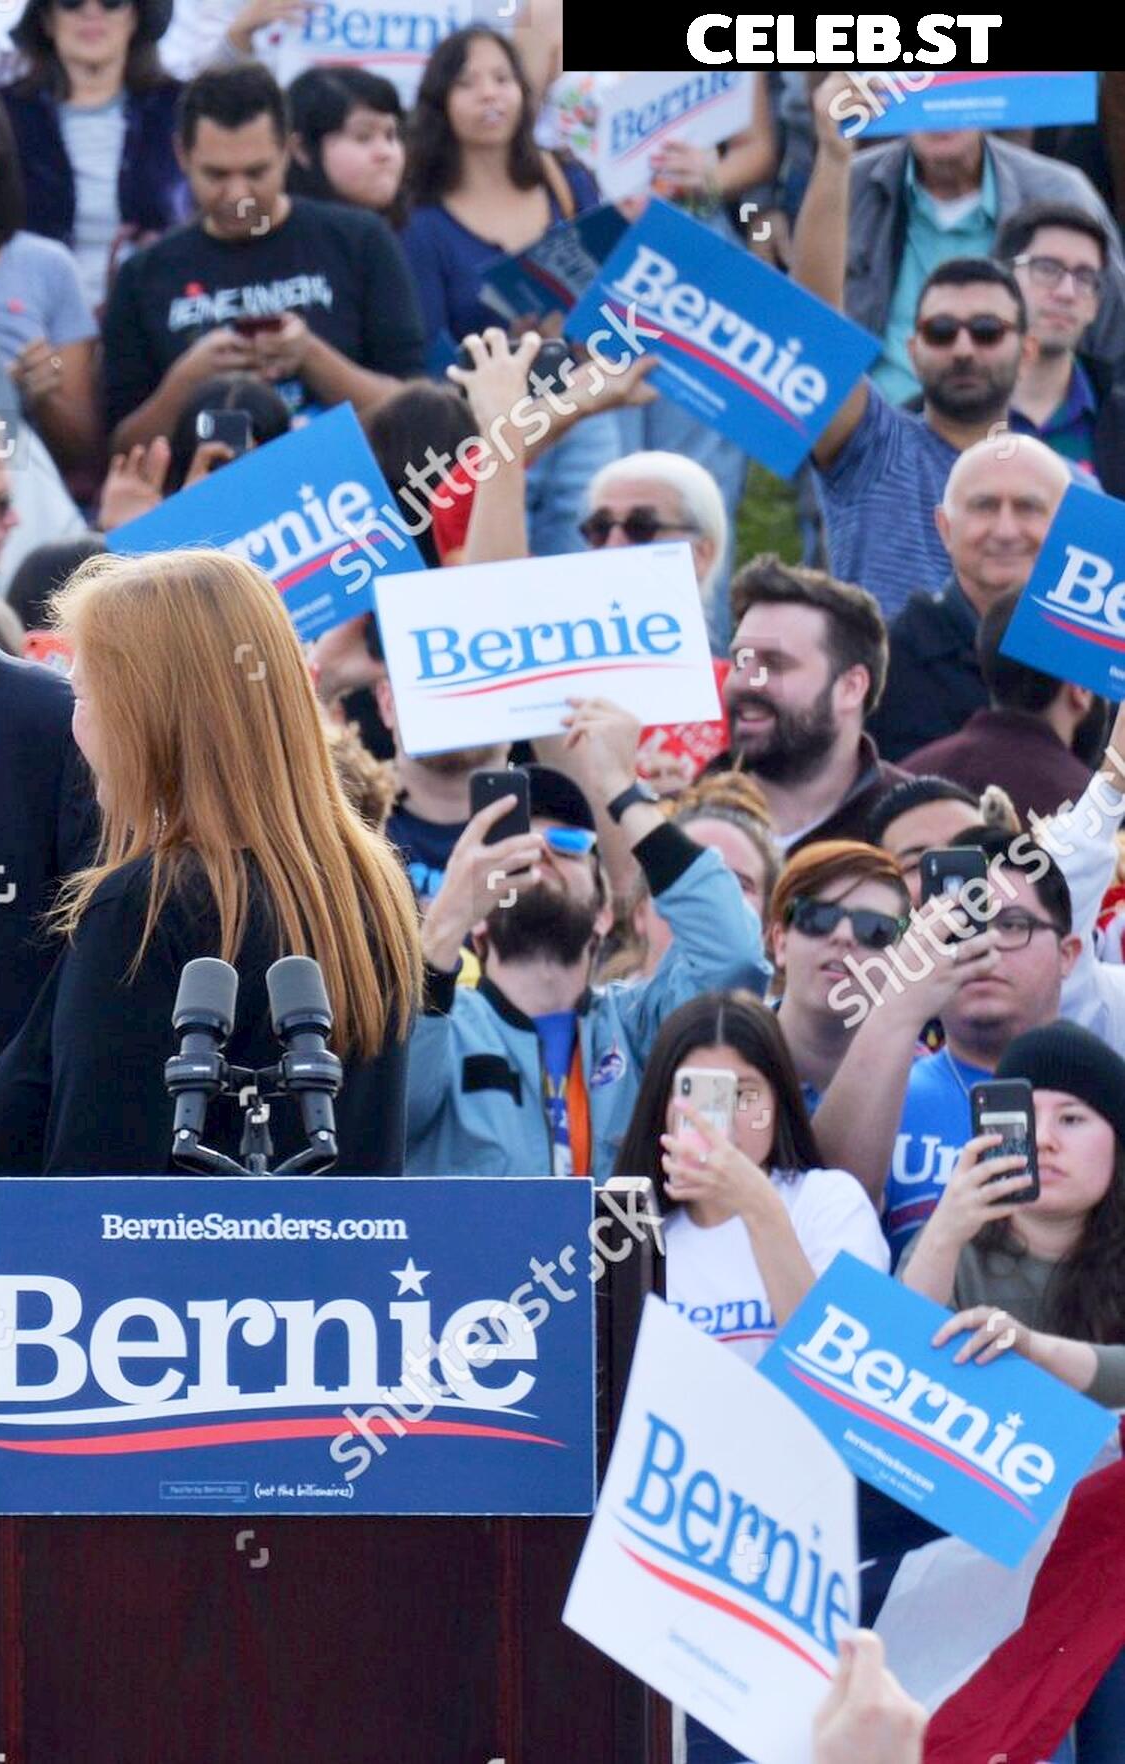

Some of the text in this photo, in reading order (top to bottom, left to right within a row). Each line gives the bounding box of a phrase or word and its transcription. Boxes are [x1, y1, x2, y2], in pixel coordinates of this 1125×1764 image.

[612, 244, 829, 419] Bernie
[408, 599, 682, 681] Bernie
[101, 1212, 408, 1241] BernieSanders.com
[796, 1302, 1057, 1497] Bernie
[254, 1482, 275, 1499] (not
[277, 1483, 295, 1497] the
